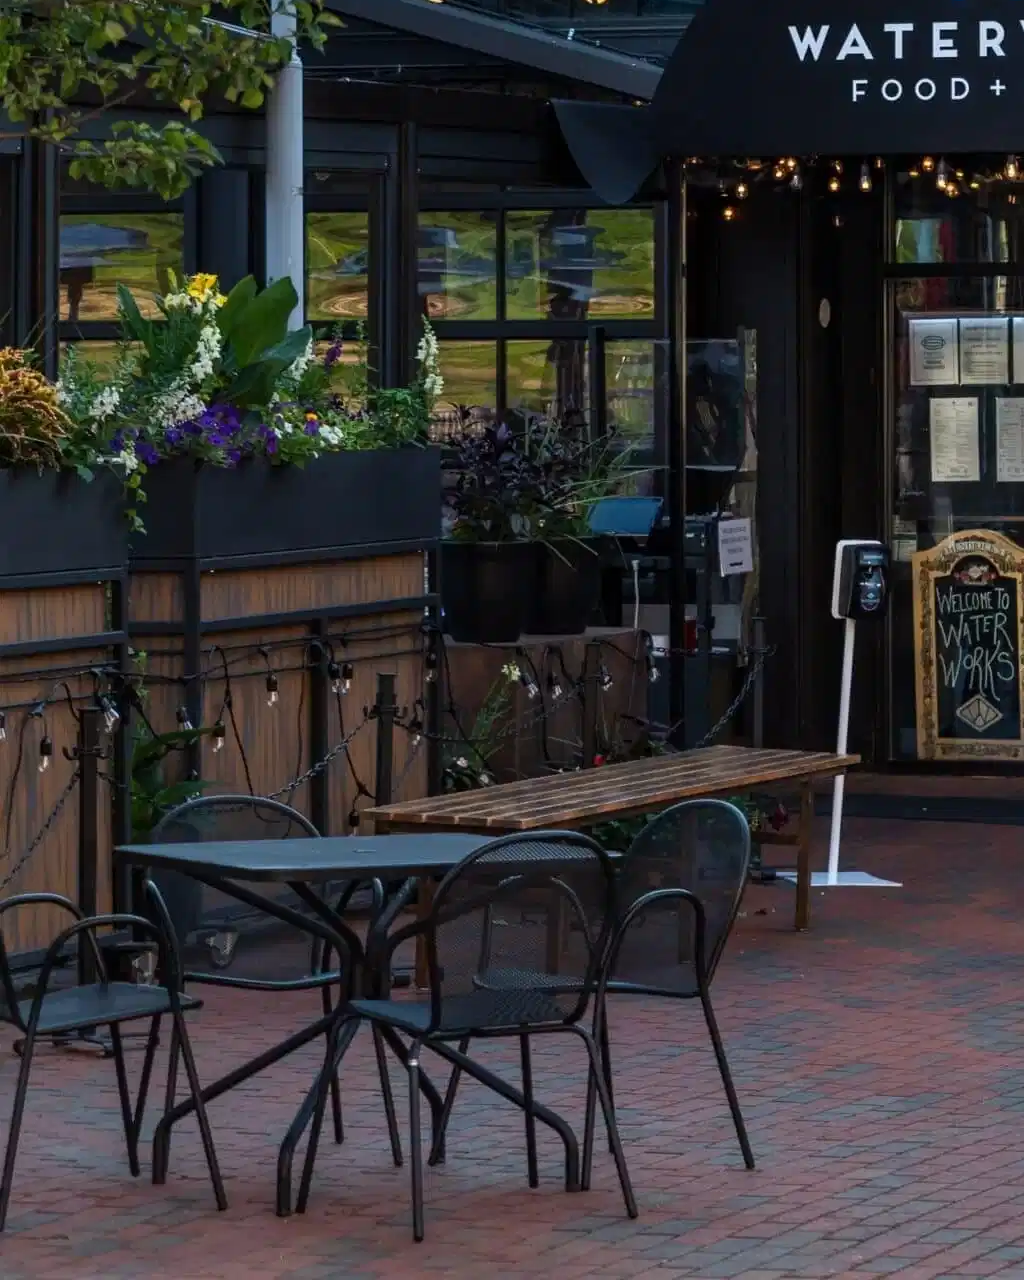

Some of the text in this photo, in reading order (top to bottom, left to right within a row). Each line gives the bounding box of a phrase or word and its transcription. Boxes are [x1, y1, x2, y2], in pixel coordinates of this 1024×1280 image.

[852, 77, 970, 102] FOOD
[936, 585, 993, 613] WELCOME
[937, 612, 1014, 652] WATER
[938, 639, 1015, 701] WORKS
